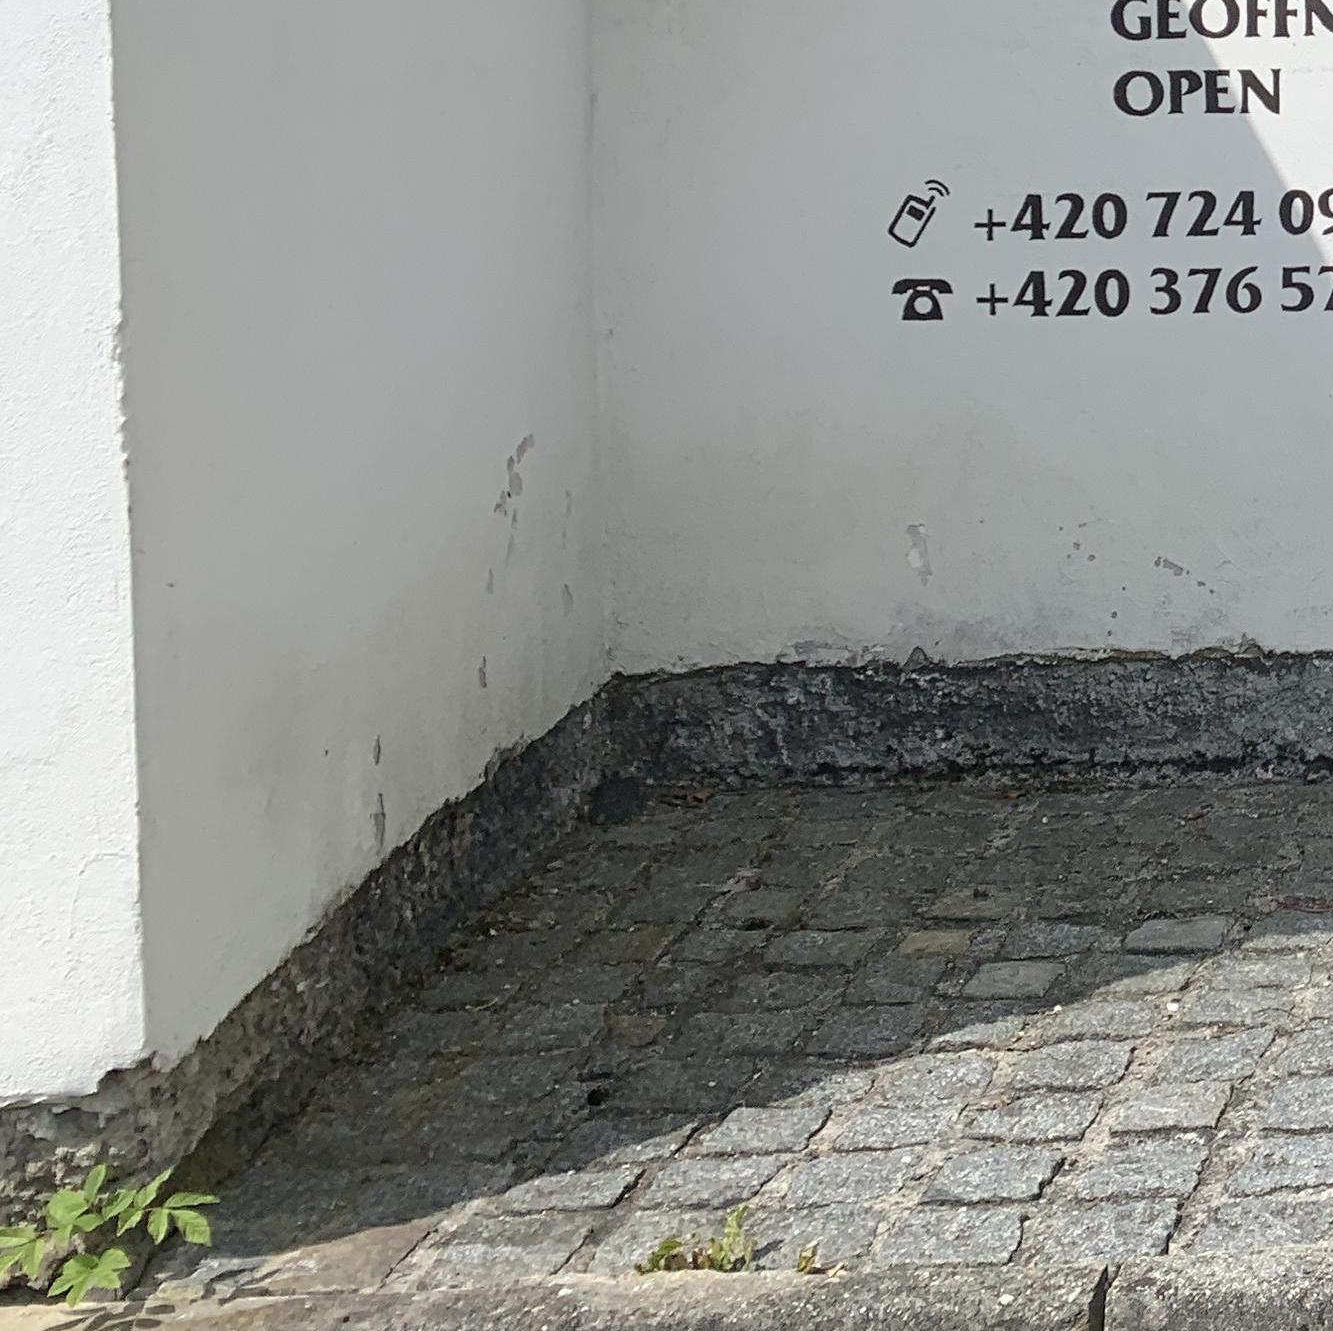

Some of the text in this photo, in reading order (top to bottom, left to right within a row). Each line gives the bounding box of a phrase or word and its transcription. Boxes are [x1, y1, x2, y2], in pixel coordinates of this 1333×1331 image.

[1112, 67, 1282, 118] OPEN
[972, 191, 1129, 243] +420
[1144, 189, 1264, 239] 724
[974, 267, 1132, 319] +420
[1148, 264, 1264, 317] 376
